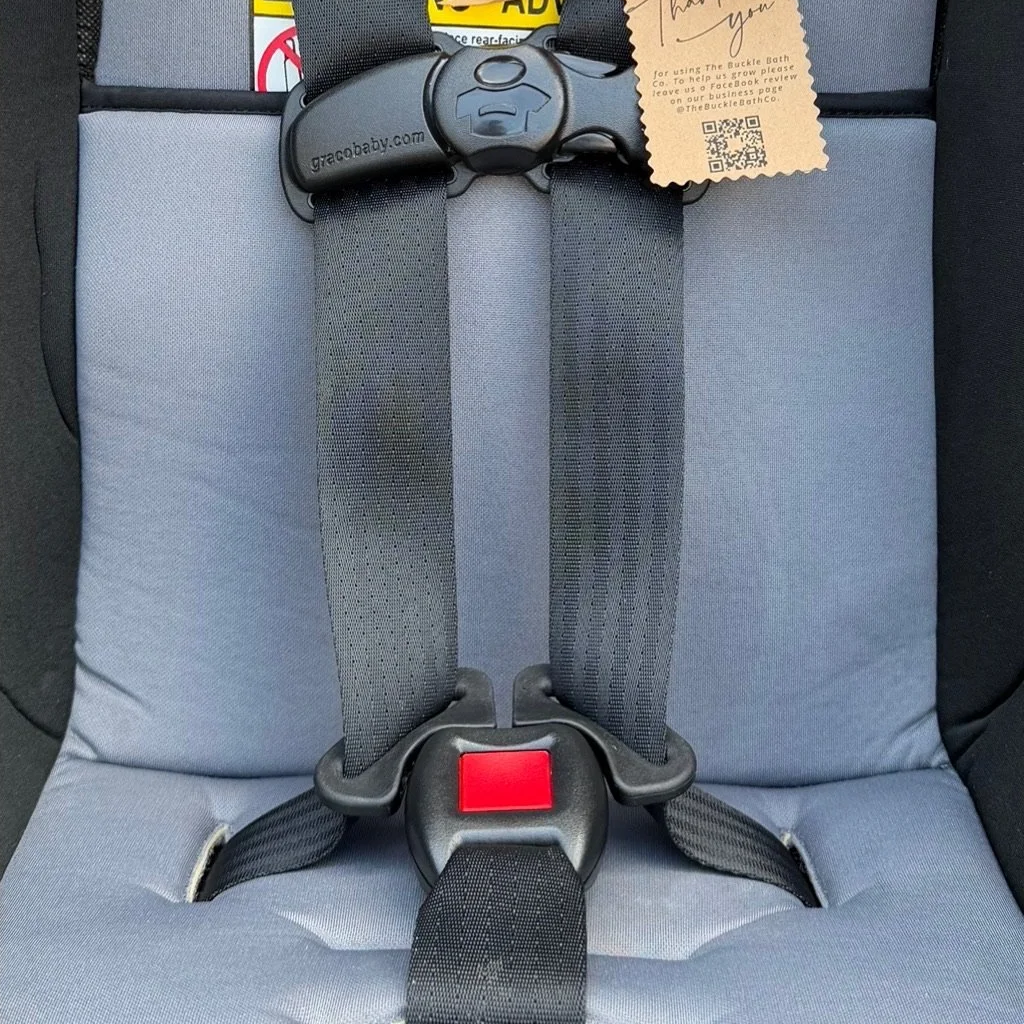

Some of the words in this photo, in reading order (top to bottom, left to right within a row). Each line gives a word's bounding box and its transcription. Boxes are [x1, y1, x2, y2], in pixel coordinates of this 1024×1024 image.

[472, 34, 525, 46] rear-faci
[676, 0, 776, 58] you
[652, 80, 669, 88] Co.
[673, 77, 685, 86] To
[689, 74, 711, 84] help
[731, 70, 757, 80] grow
[761, 64, 795, 76] please
[653, 70, 669, 80] for
[673, 66, 701, 76] using
[706, 63, 723, 72] The
[727, 58, 761, 69] Buckle
[766, 54, 790, 65] Bath
[652, 88, 680, 97] leave
[684, 86, 696, 94] us
[710, 78, 760, 90] FaceBook
[764, 74, 798, 84] review
[670, 98, 682, 106] on
[687, 95, 705, 103] our
[709, 89, 754, 101] business
[758, 85, 783, 96] page
[310, 130, 426, 173] gracobaby.com
